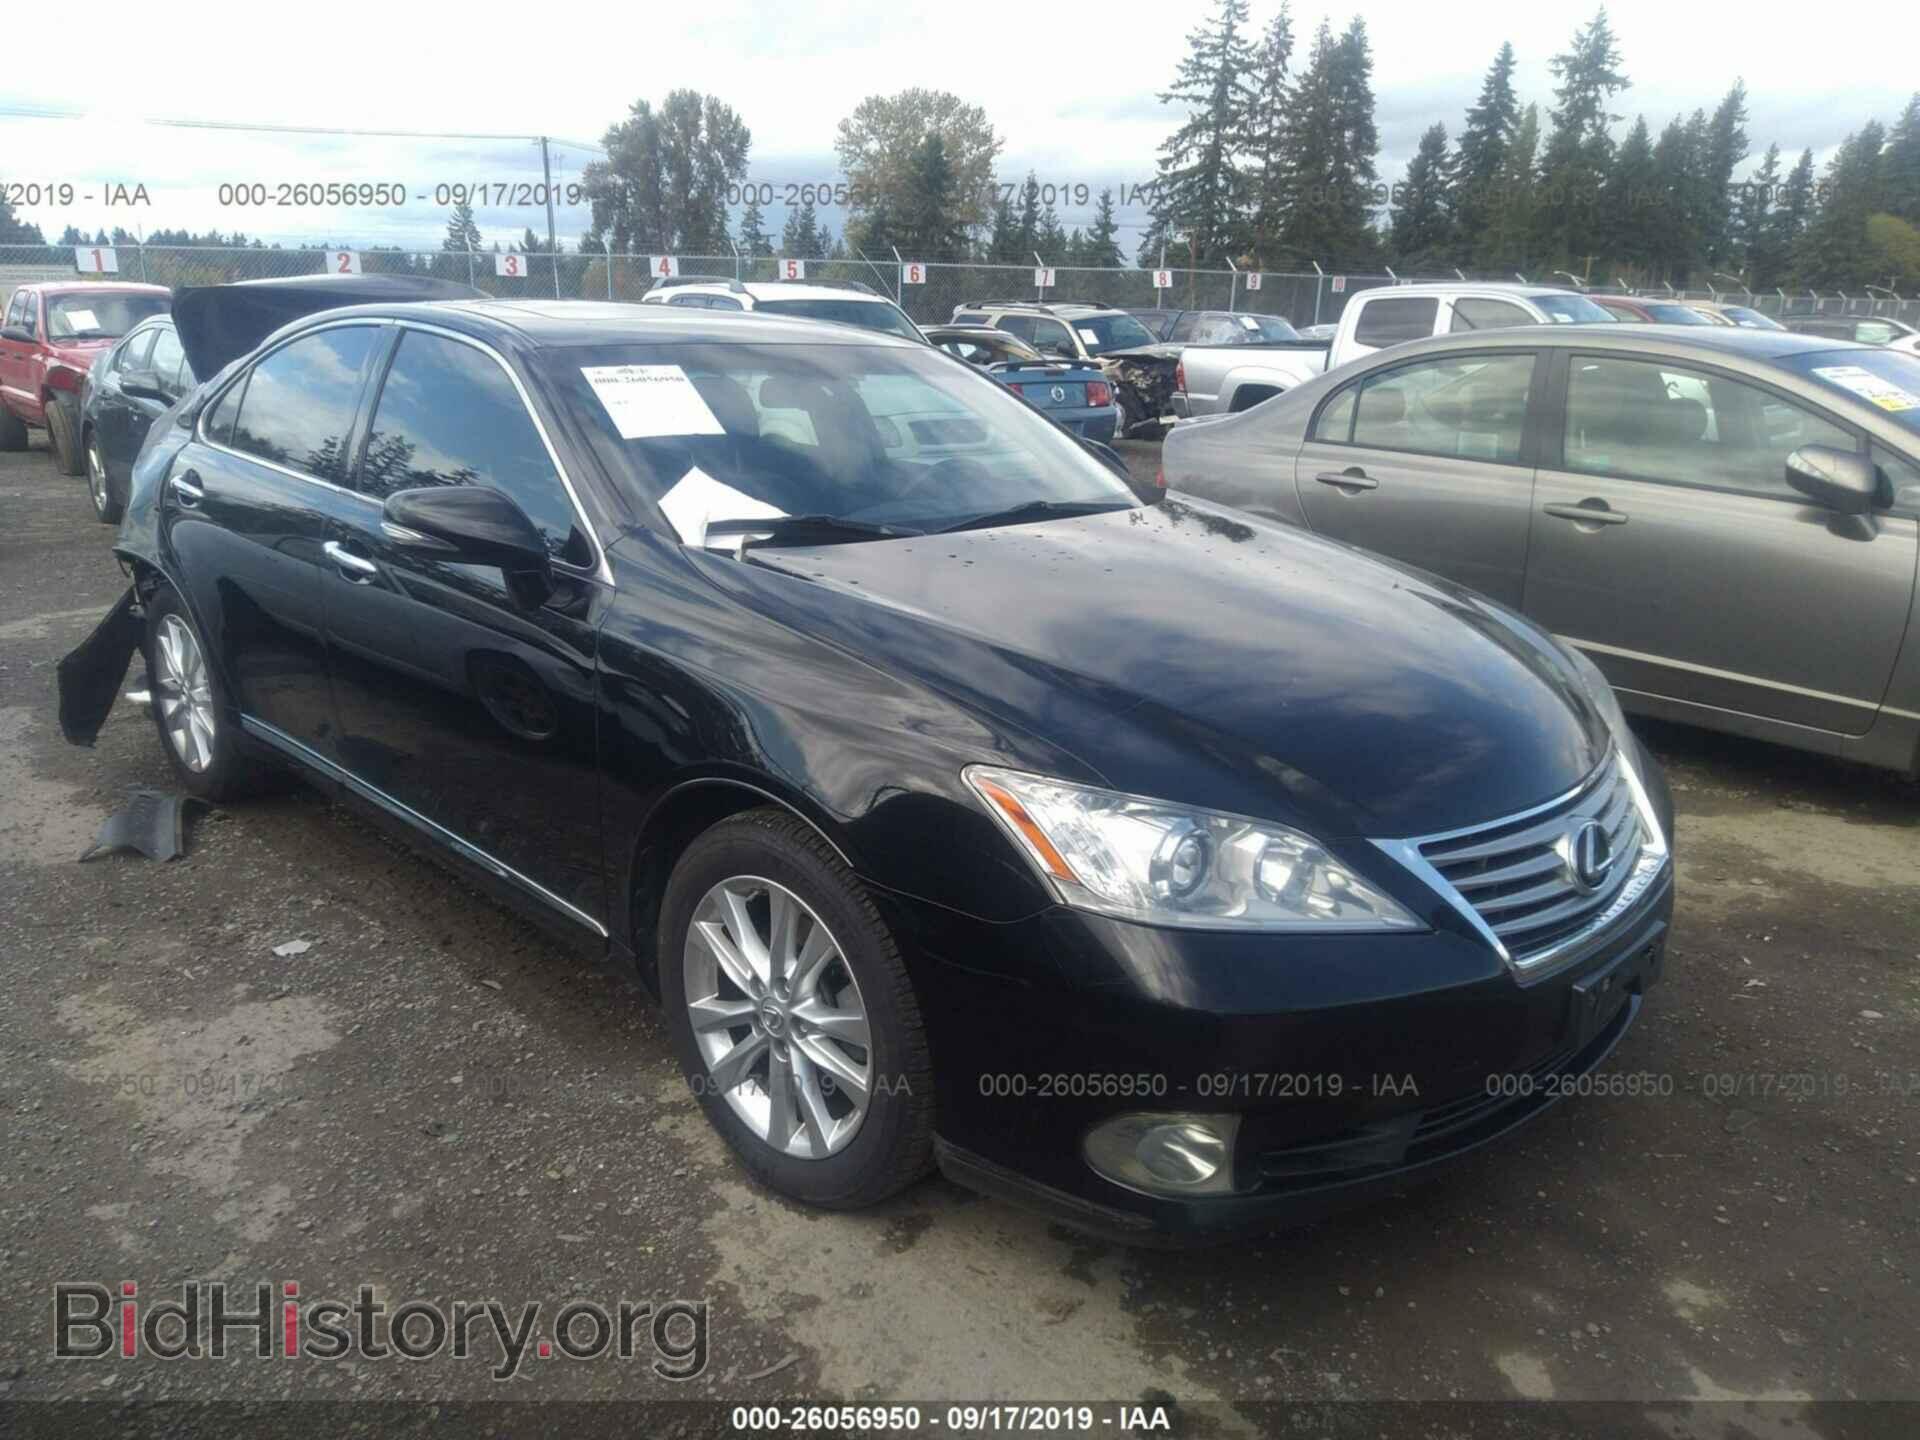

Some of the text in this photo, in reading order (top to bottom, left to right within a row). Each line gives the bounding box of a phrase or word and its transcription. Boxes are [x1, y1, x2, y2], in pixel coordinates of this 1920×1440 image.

[91, 248, 104, 272] 1
[336, 253, 353, 273] 2
[504, 255, 518, 276] 3
[658, 256, 671, 275] 4
[786, 261, 797, 279] 5
[910, 265, 920, 282] 6
[1041, 270, 1050, 284] 7
[1159, 271, 1168, 286] 8
[1250, 273, 1258, 288] 9
